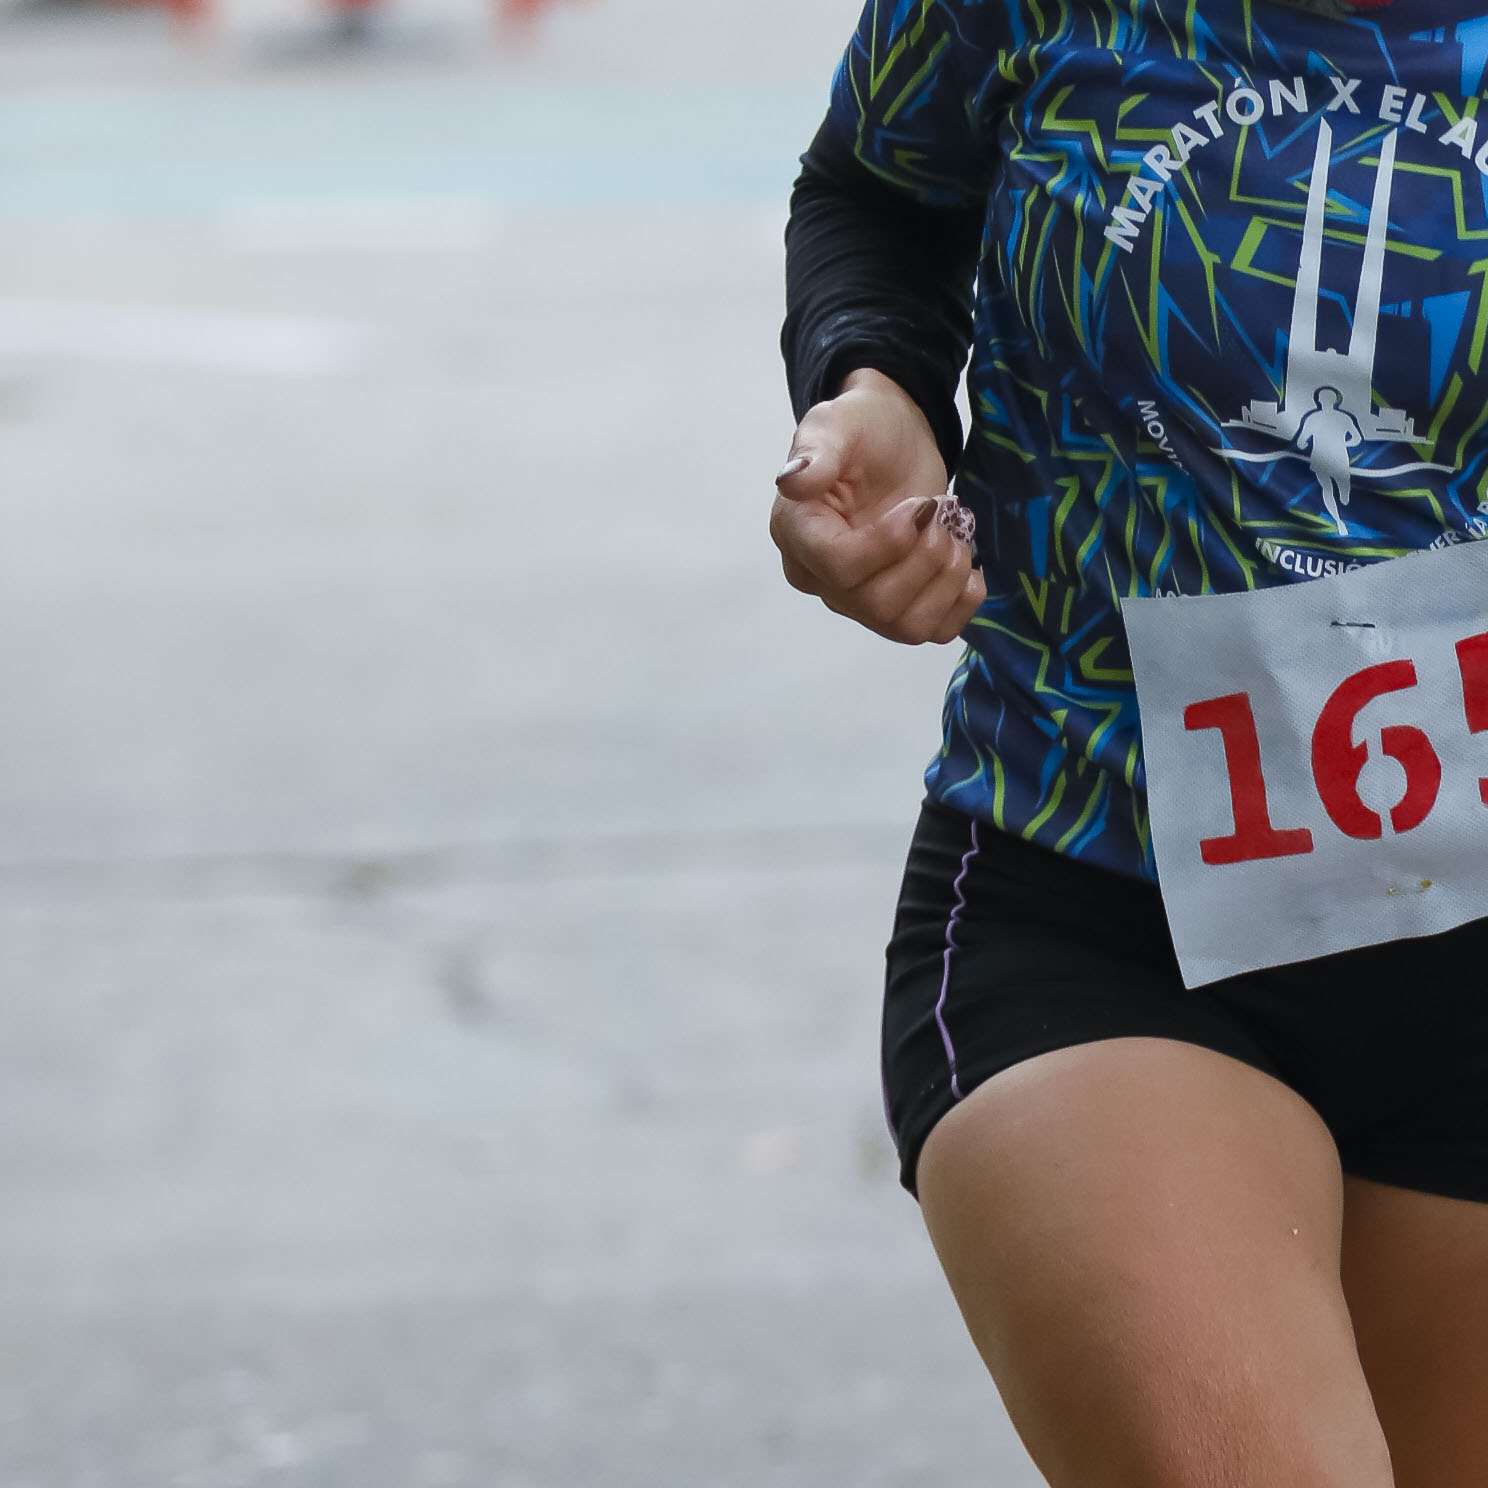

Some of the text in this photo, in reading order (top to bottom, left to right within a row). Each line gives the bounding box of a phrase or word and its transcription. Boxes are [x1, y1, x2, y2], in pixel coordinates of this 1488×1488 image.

[1104, 77, 1308, 253] MARATÓN
[1327, 76, 1361, 114] X
[1379, 84, 1428, 134] EL
